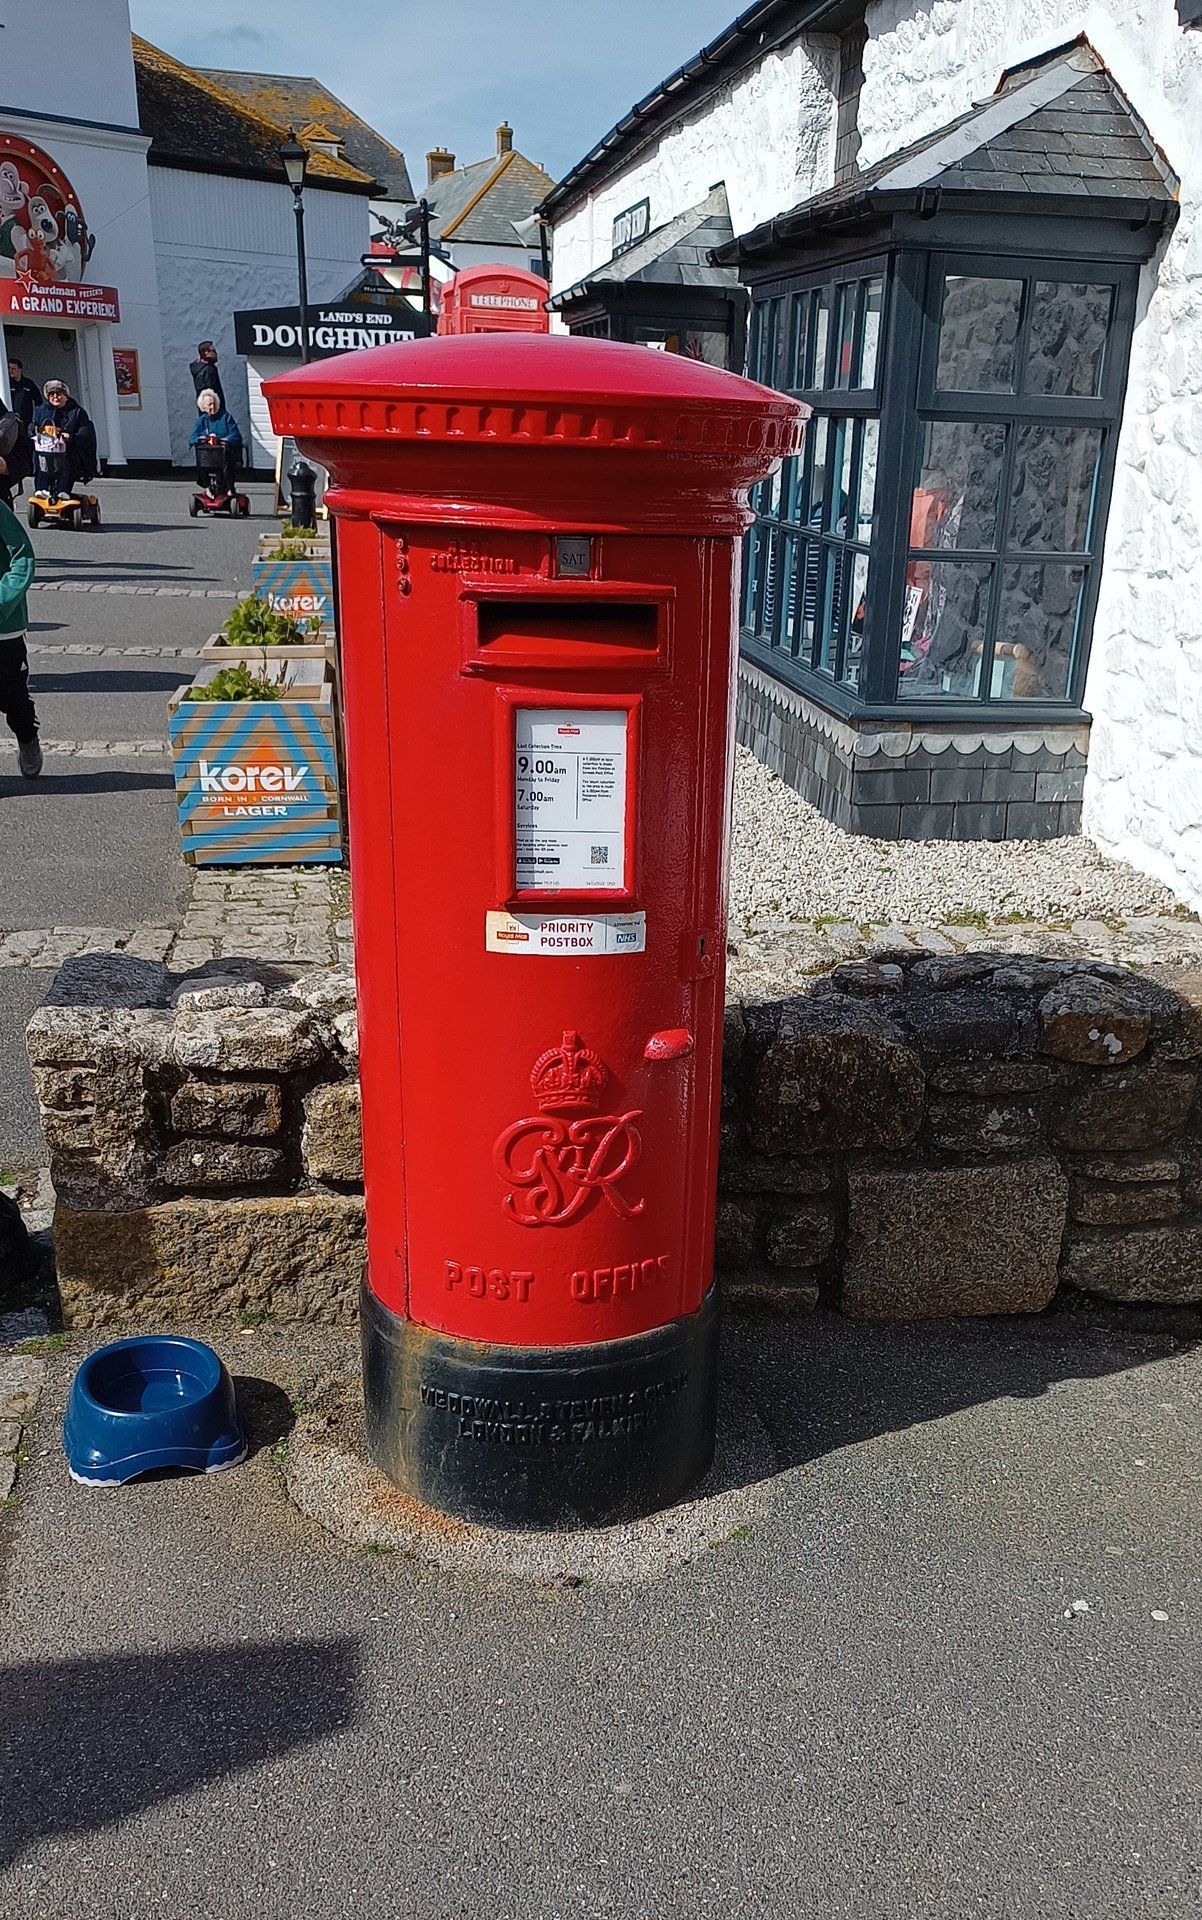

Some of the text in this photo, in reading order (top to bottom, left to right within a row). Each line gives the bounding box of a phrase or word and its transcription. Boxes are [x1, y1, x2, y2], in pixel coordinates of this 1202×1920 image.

[31, 284, 76, 296] Aardman
[11, 295, 20, 310] A
[22, 297, 63, 312] GRAND
[475, 294, 534, 309] TELEPHONE
[319, 311, 393, 325] LAND'S END
[561, 552, 586, 565] SAT
[267, 592, 327, 612] korev
[518, 756, 567, 775] 9.00am
[199, 759, 309, 792] korev
[517, 788, 554, 802] 7.00am
[224, 806, 288, 816] LAGER
[540, 922, 594, 933] PRIORITY
[498, 932, 514, 940] Royal
[540, 937, 594, 947] POSTBOX
[617, 934, 636, 943] NHS
[444, 1259, 535, 1301] POST
